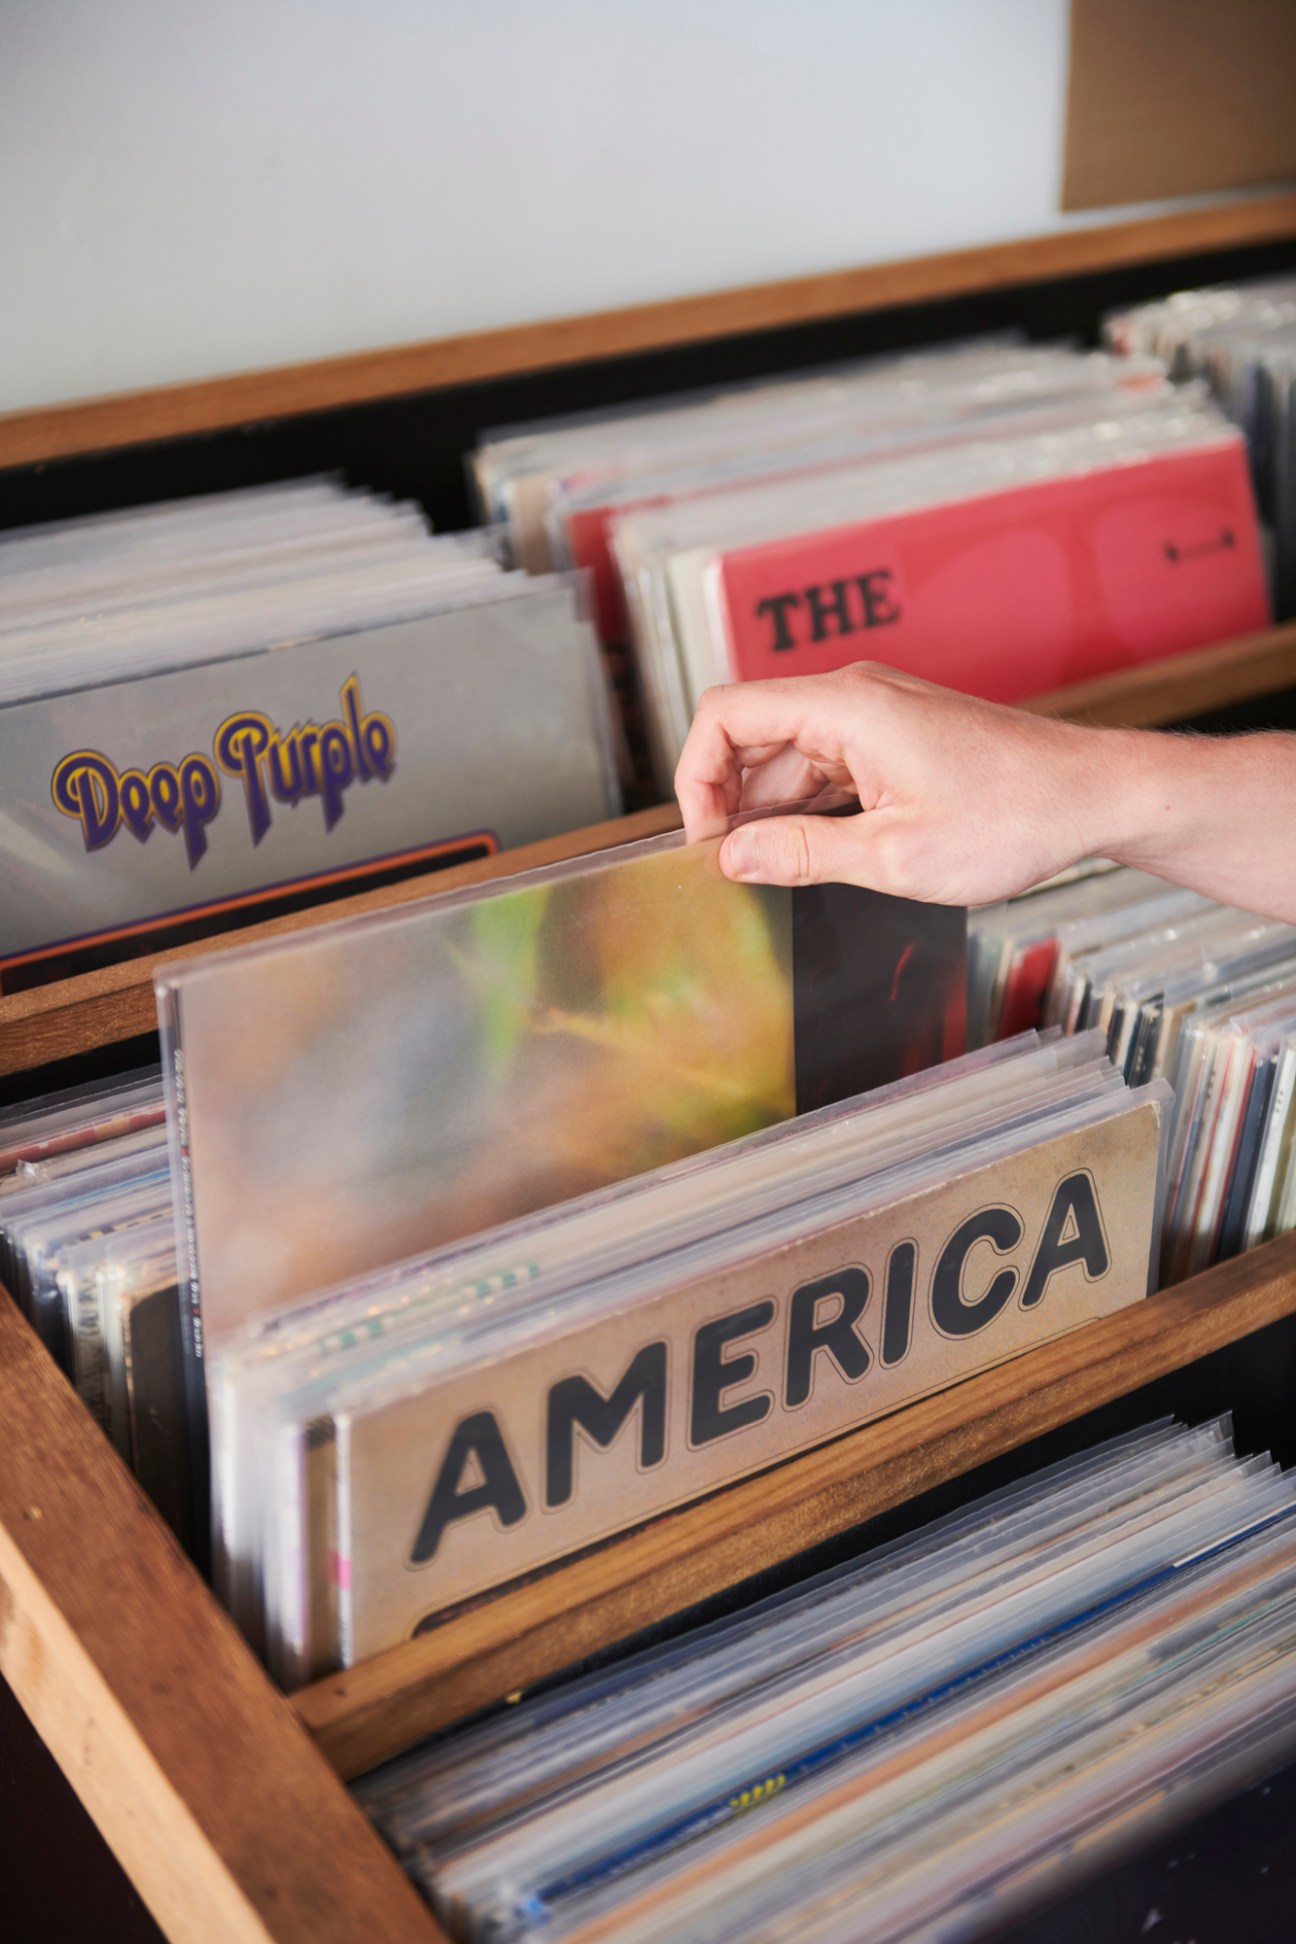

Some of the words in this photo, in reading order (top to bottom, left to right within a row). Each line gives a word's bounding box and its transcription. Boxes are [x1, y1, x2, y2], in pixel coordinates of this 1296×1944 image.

[757, 569, 900, 651] THE
[52, 750, 220, 872] Deep
[213, 671, 396, 848] Purple
[409, 1169, 1109, 1565] AMERICA
